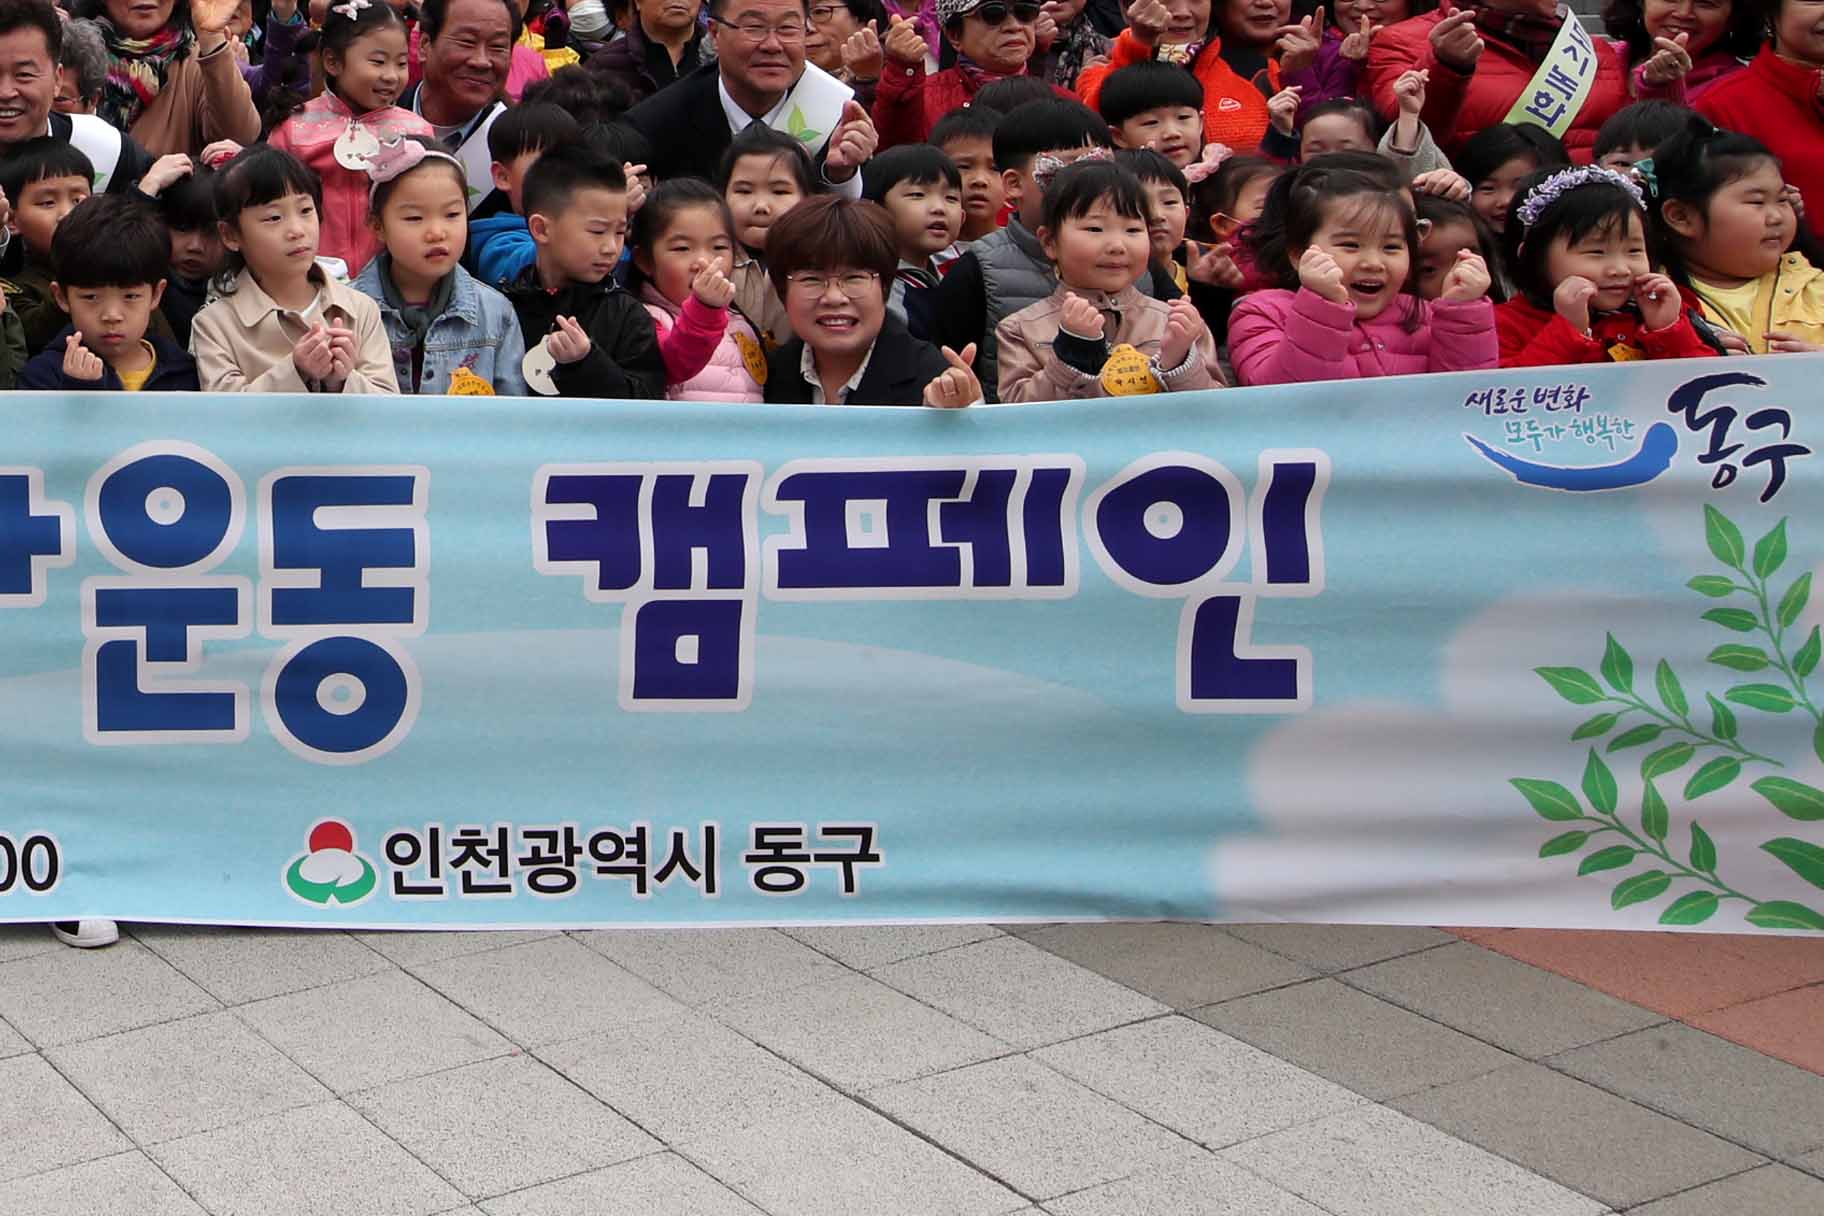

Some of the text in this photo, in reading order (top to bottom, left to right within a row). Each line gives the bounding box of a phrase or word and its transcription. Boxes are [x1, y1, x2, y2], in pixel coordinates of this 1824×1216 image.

[1464, 384, 1591, 415] 새로운 변화
[1505, 414, 1635, 452] 모두가 행복한
[1667, 372, 1812, 503] 동구
[544, 461, 1317, 700] 캠페인
[385, 826, 882, 897] 인천광역시 동구
